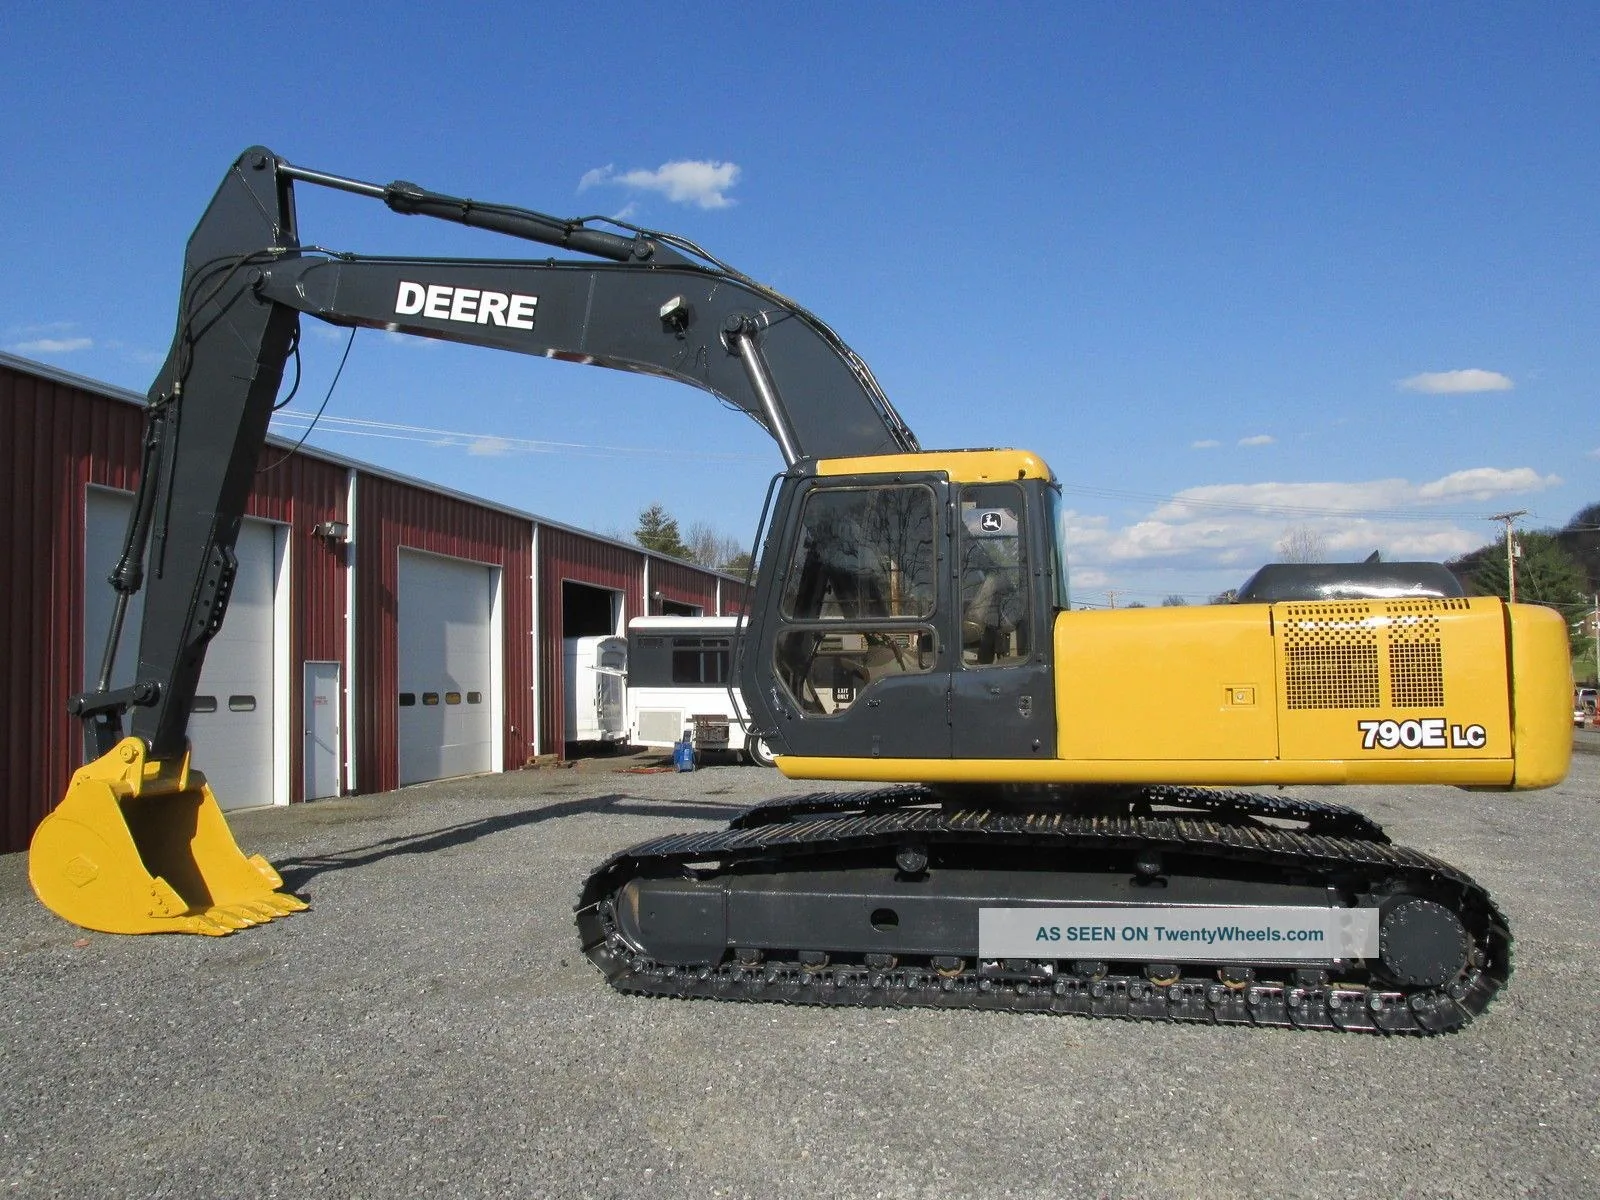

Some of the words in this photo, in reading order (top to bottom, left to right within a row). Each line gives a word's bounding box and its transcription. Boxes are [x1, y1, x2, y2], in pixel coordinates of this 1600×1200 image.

[395, 281, 538, 330] DEERE
[1358, 718, 1447, 749] 790E
[1451, 725, 1486, 749] LC
